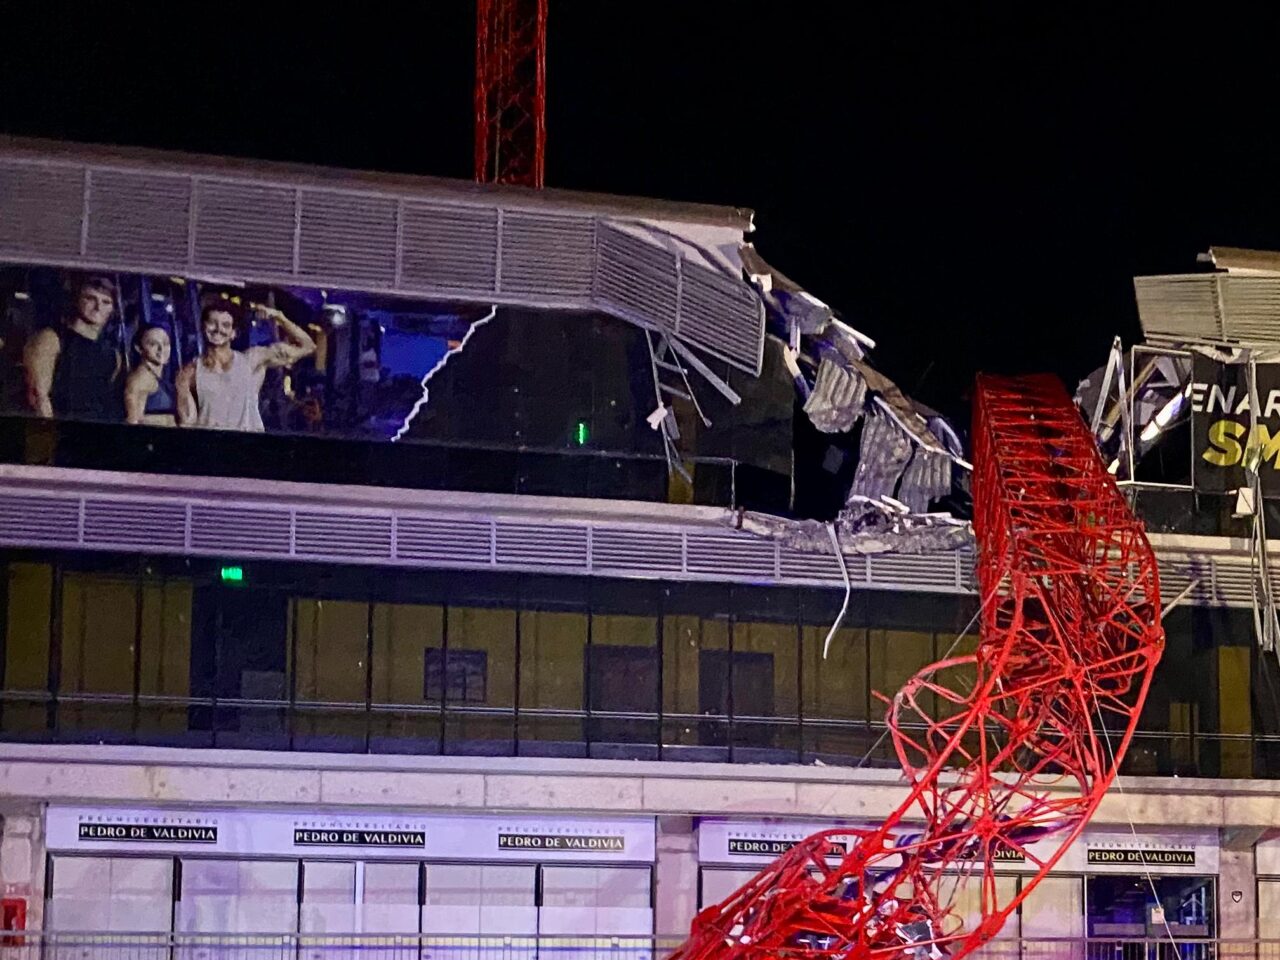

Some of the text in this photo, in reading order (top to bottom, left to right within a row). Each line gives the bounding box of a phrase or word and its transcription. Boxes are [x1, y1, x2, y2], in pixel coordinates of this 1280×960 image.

[80, 826, 215, 839] PEDRO DE VALDIVIA
[295, 832, 423, 844] PEDRO DE VALDIVIA
[500, 836, 622, 849] PEDRO DE VALDIVIA
[729, 841, 769, 851] PEDRO
[1089, 851, 1193, 862] PEDRO DE VALDIVIA
